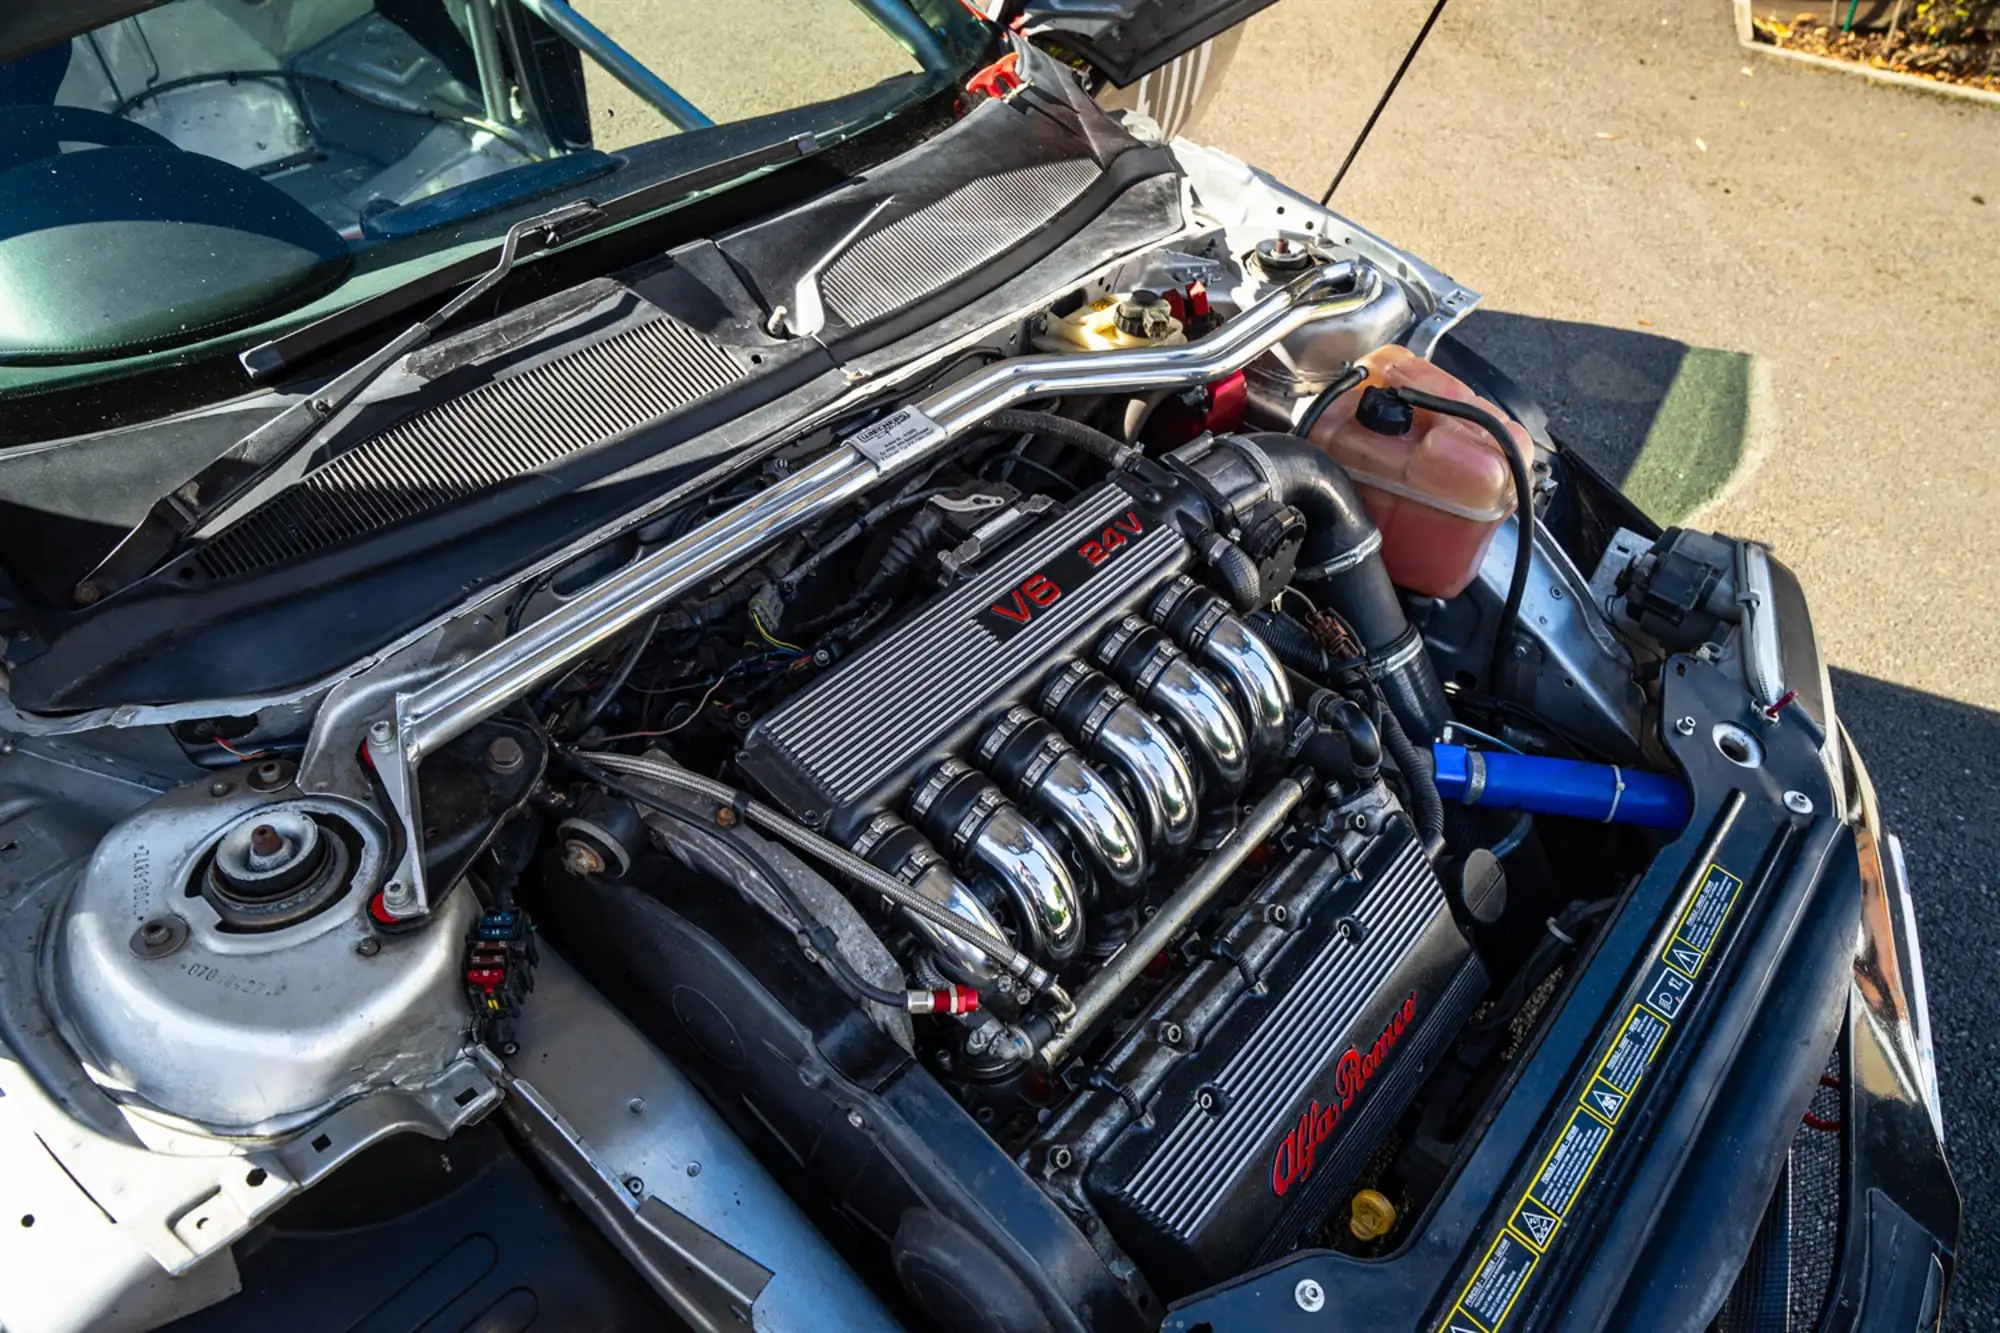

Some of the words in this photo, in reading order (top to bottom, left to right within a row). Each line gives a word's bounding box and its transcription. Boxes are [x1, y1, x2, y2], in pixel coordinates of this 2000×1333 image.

[991, 574, 1062, 624] V6
[1078, 511, 1143, 568] 24V
[1272, 1100, 1340, 1197] Alfa
[1335, 991, 1417, 1111] Romeo
